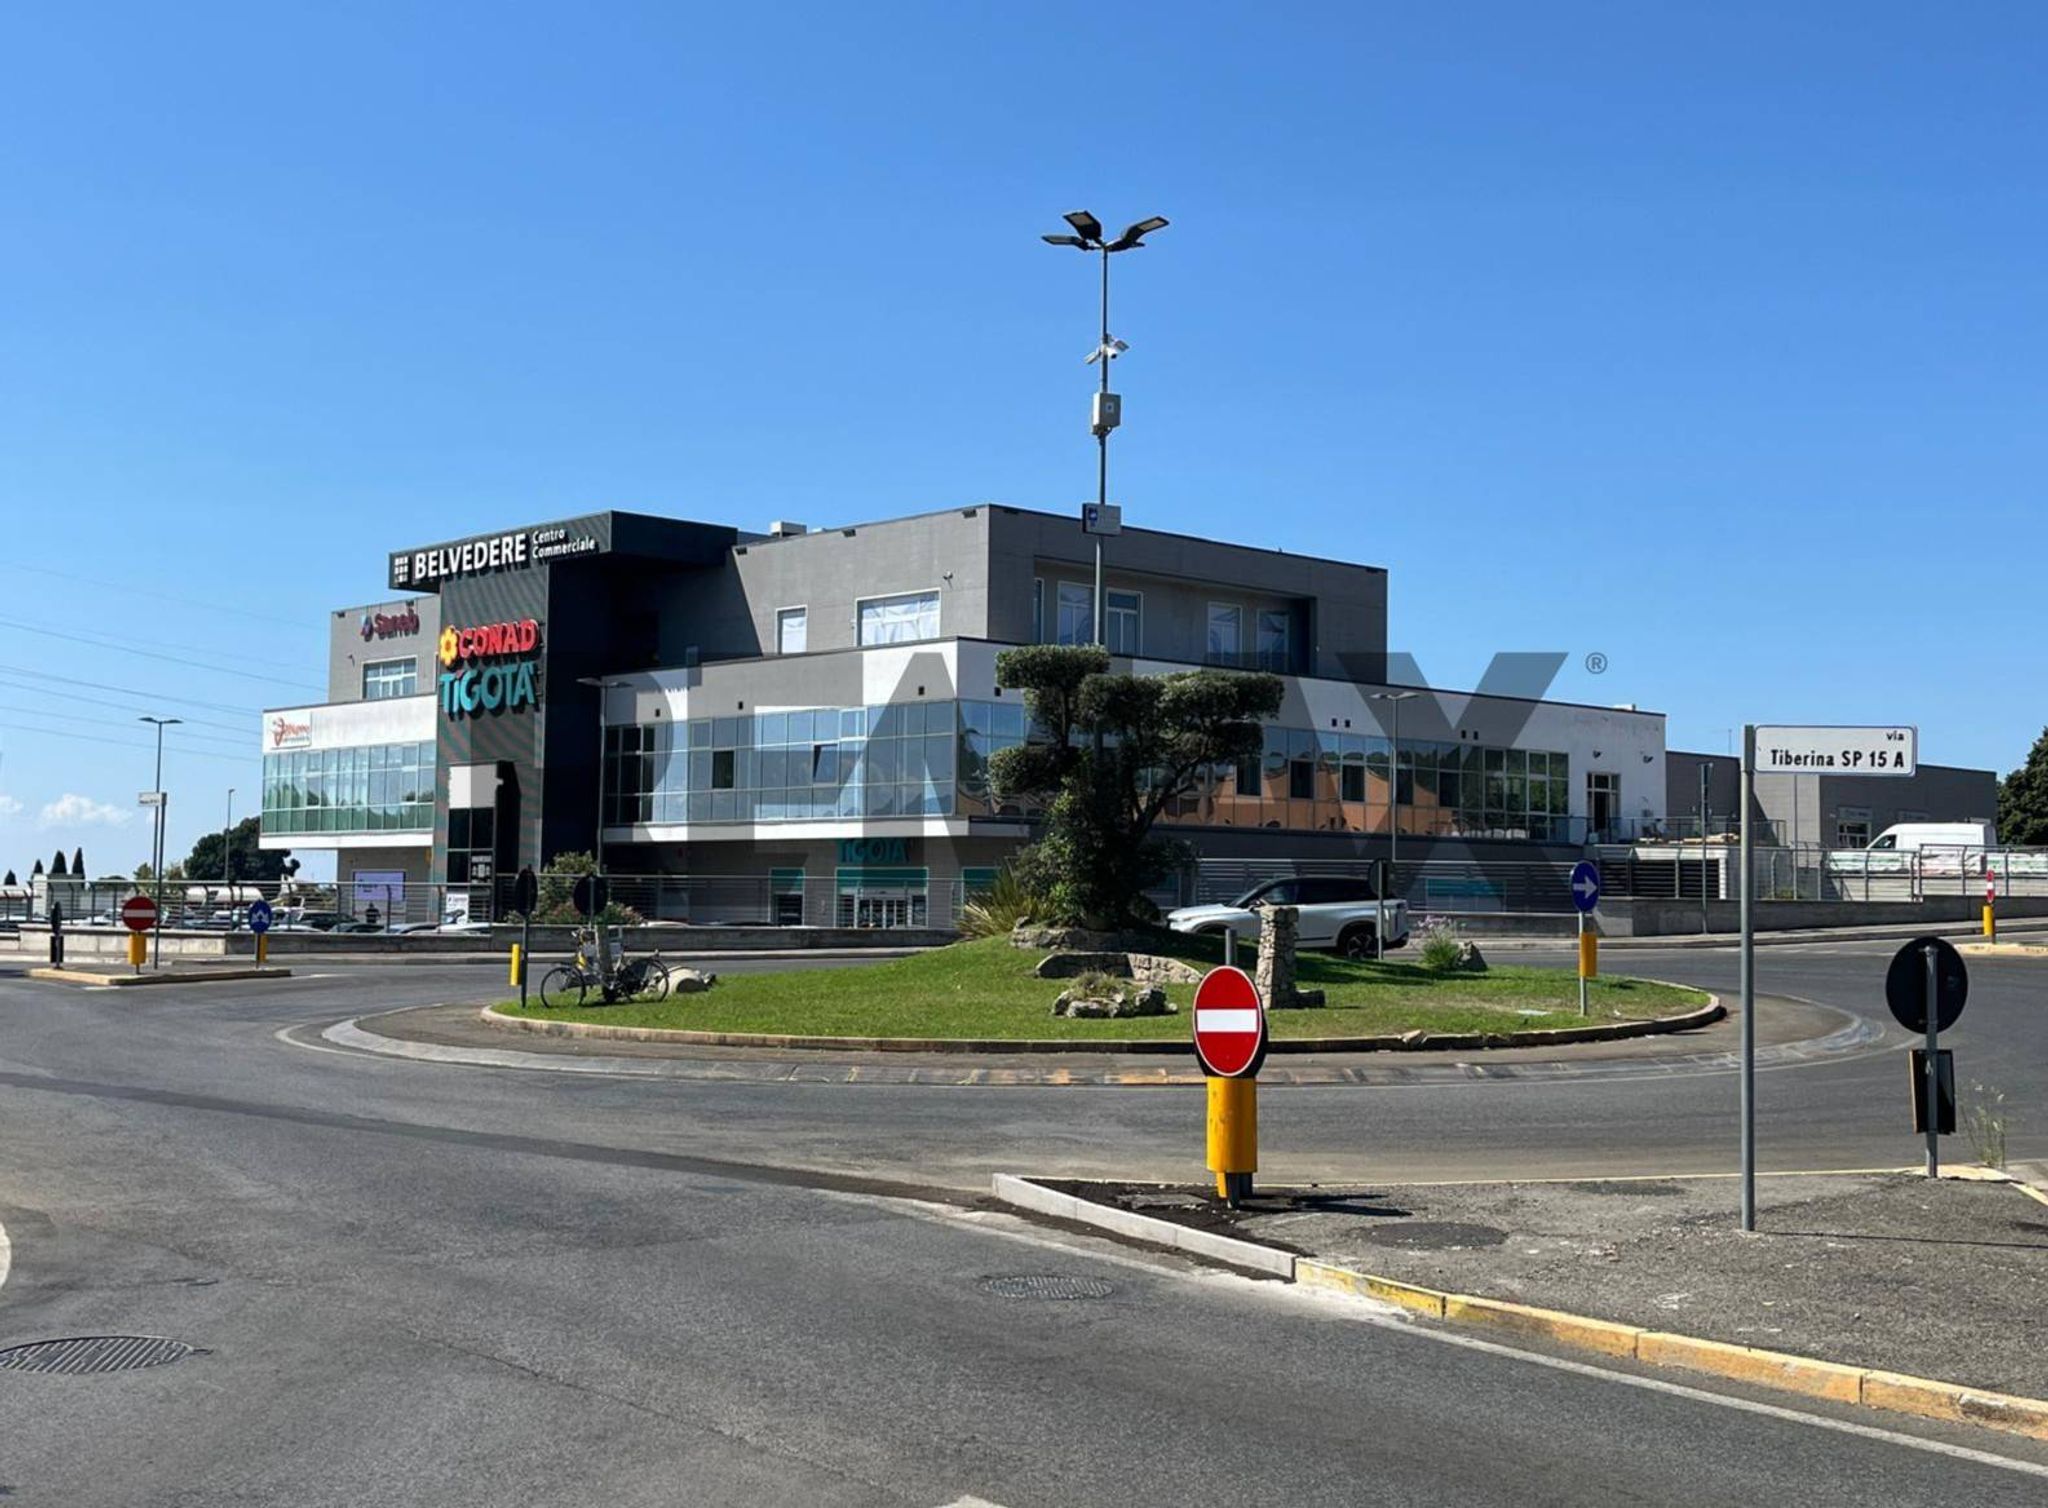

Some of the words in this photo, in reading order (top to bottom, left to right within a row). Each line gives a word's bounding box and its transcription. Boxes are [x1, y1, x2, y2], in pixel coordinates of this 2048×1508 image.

[532, 529, 566, 544] Centro
[532, 535, 596, 559] Commerciale
[414, 533, 527, 579] BELVEDERE
[458, 618, 539, 658] CONAD
[1886, 730, 1905, 741] via
[1770, 749, 1835, 766] Tiberina
[1841, 750, 1863, 767] SP
[1869, 750, 1888, 768] 15
[1894, 750, 1905, 768] A
